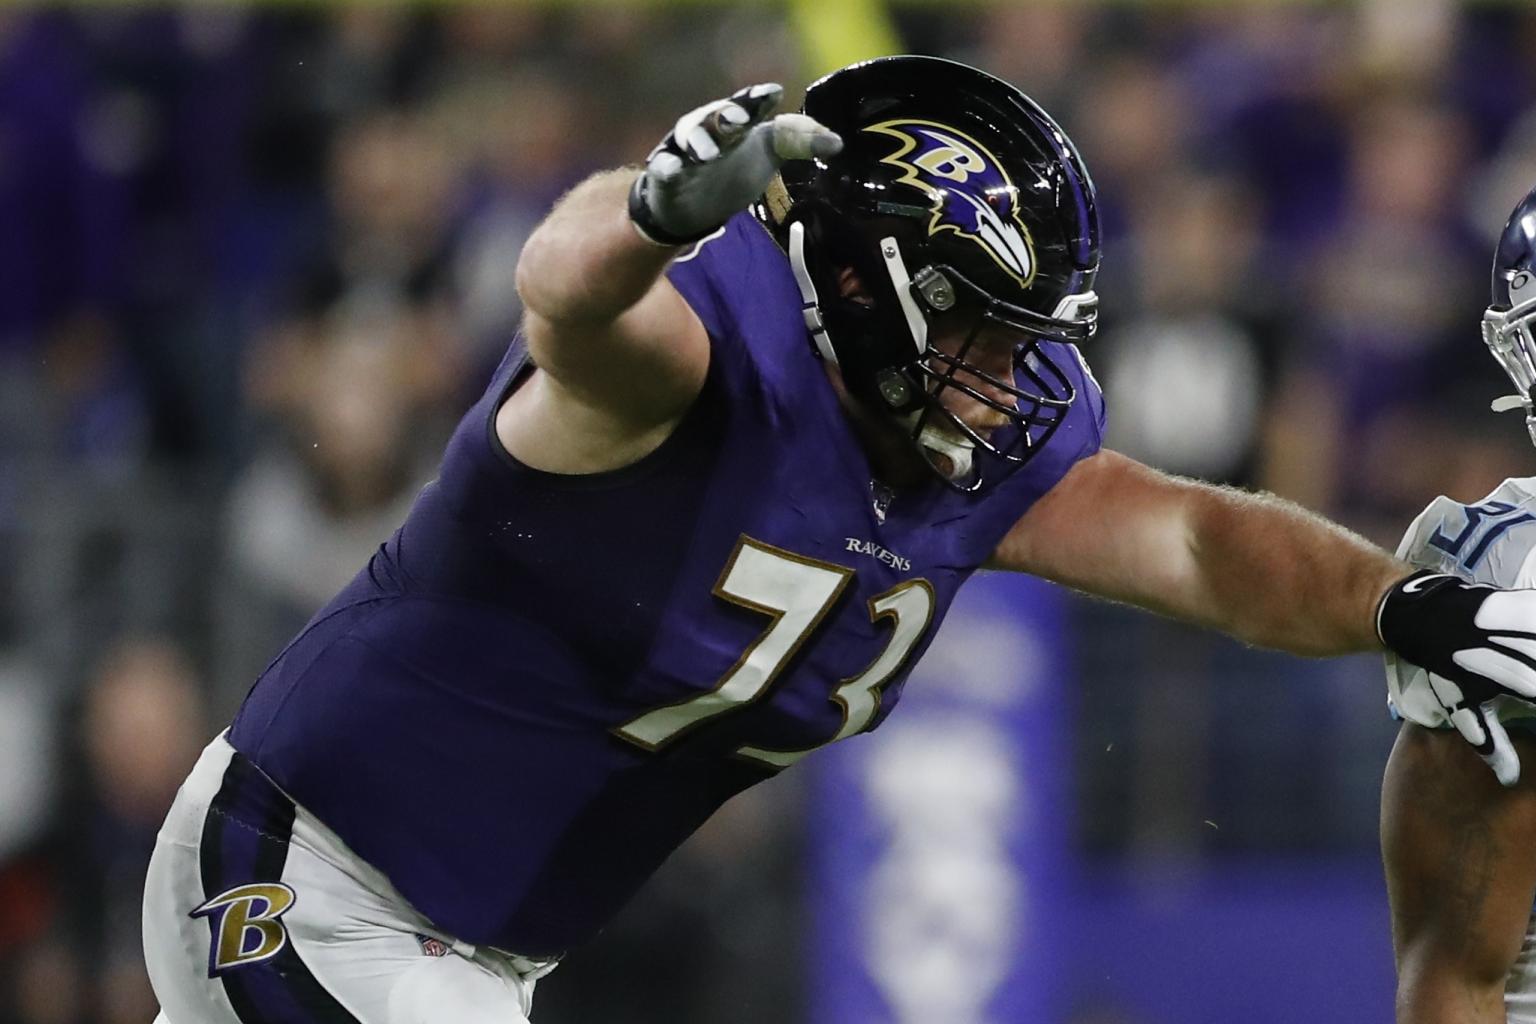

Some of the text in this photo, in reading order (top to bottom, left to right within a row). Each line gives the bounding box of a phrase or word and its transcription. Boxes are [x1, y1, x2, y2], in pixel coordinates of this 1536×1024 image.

[845, 537, 912, 572] RAVENS
[608, 532, 936, 767] 73
[188, 880, 297, 979] B
